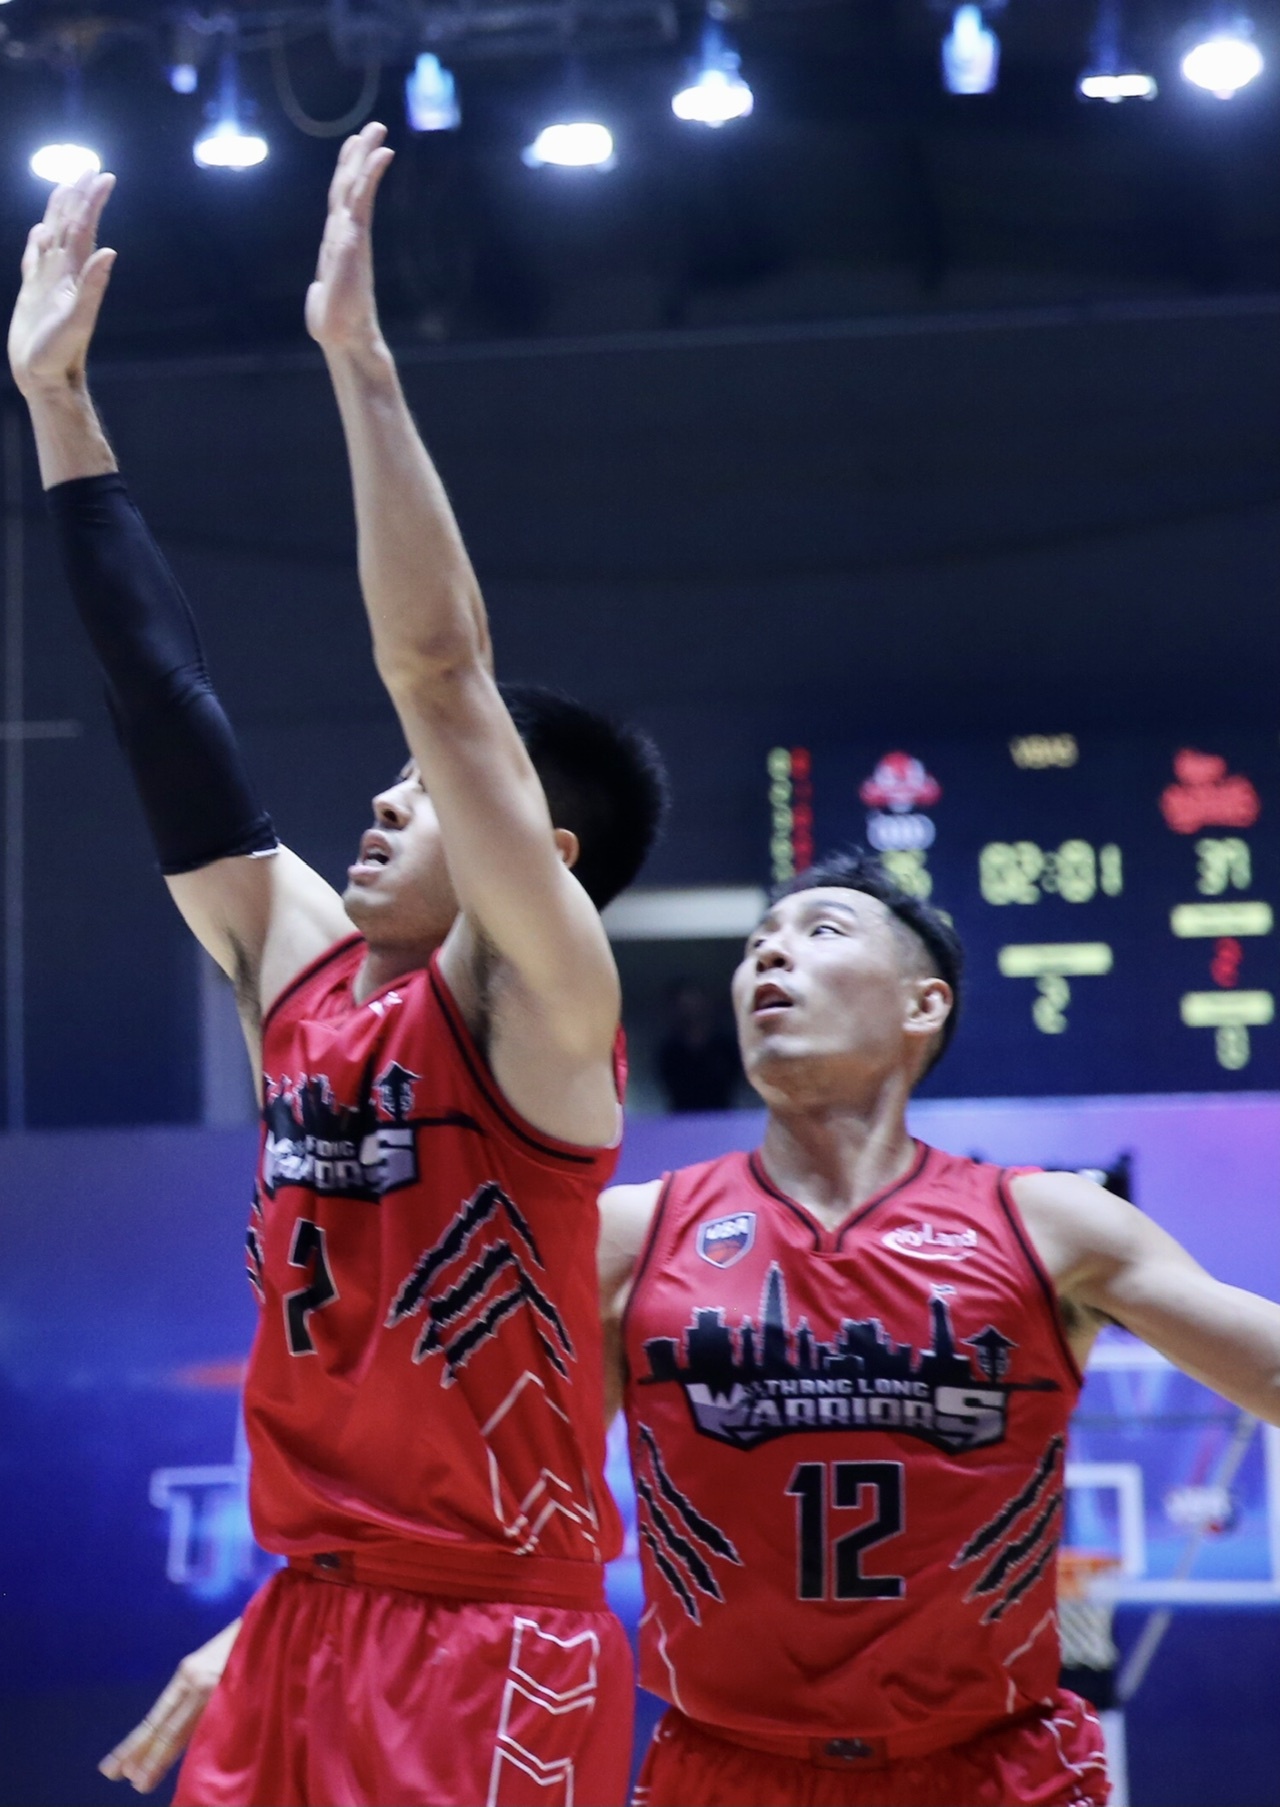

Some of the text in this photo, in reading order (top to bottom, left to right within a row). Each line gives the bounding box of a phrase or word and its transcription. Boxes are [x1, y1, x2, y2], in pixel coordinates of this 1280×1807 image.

[686, 1382, 1006, 1448] WARRIORS
[858, 1377, 930, 1399] LONG
[784, 1461, 906, 1602] 12
